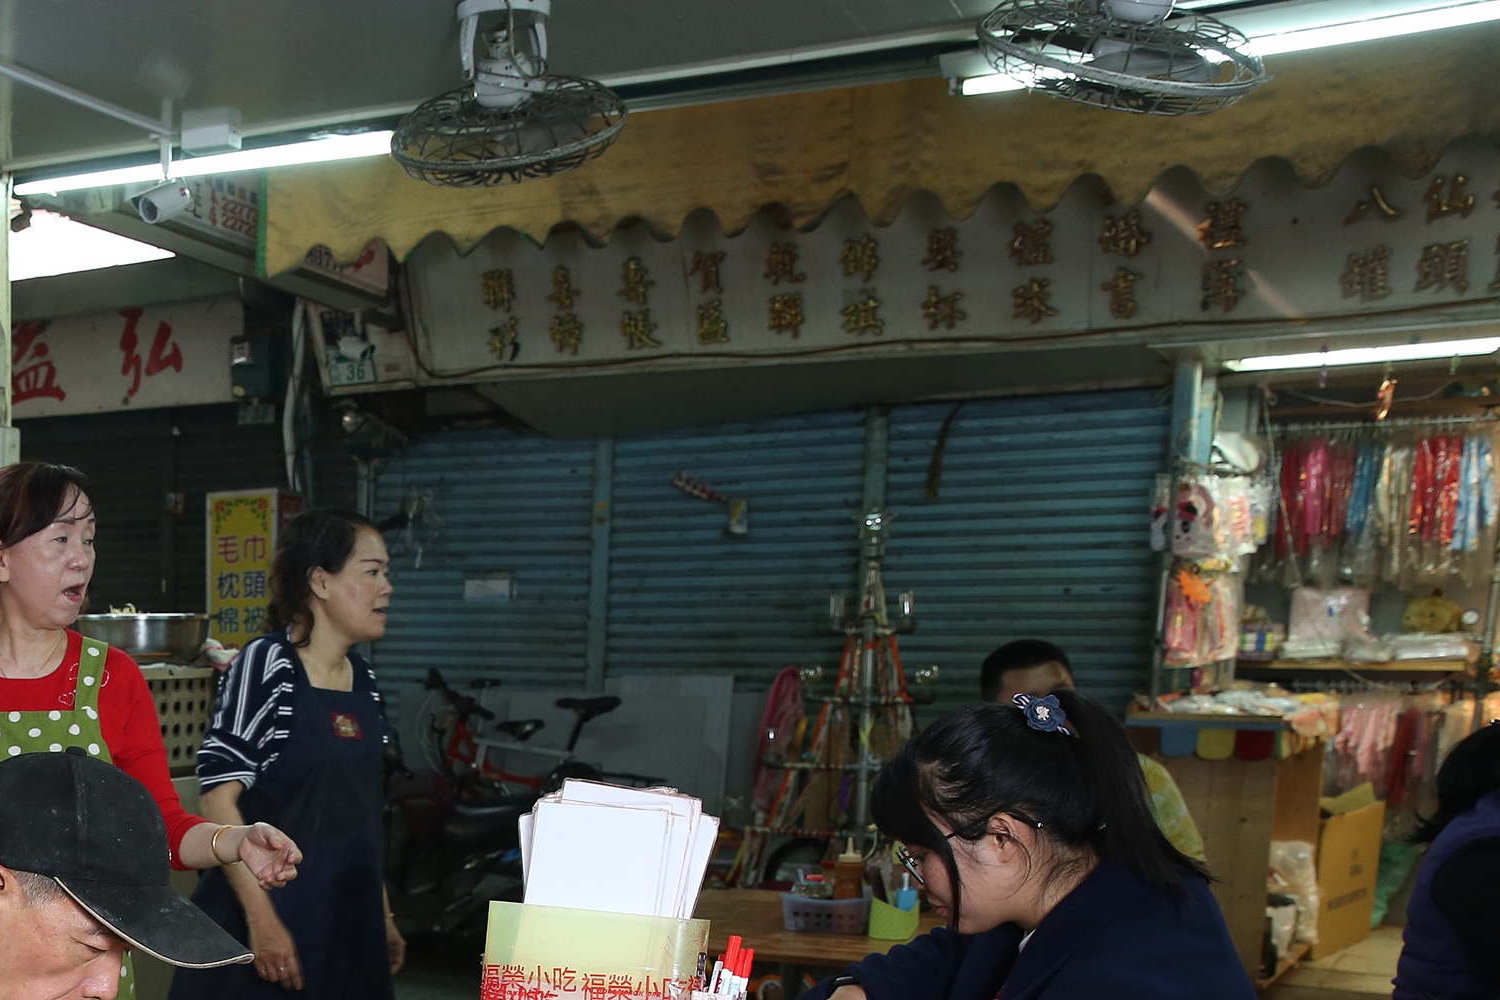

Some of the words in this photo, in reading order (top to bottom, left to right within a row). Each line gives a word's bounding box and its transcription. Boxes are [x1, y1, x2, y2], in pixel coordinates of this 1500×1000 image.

[1344, 170, 1500, 225] 八仙
[1340, 236, 1500, 302] 罐頭
[347, 364, 365, 381] 36
[217, 534, 267, 564] 毛巾
[217, 571, 267, 599] 枕頭
[217, 606, 266, 634] 棉被
